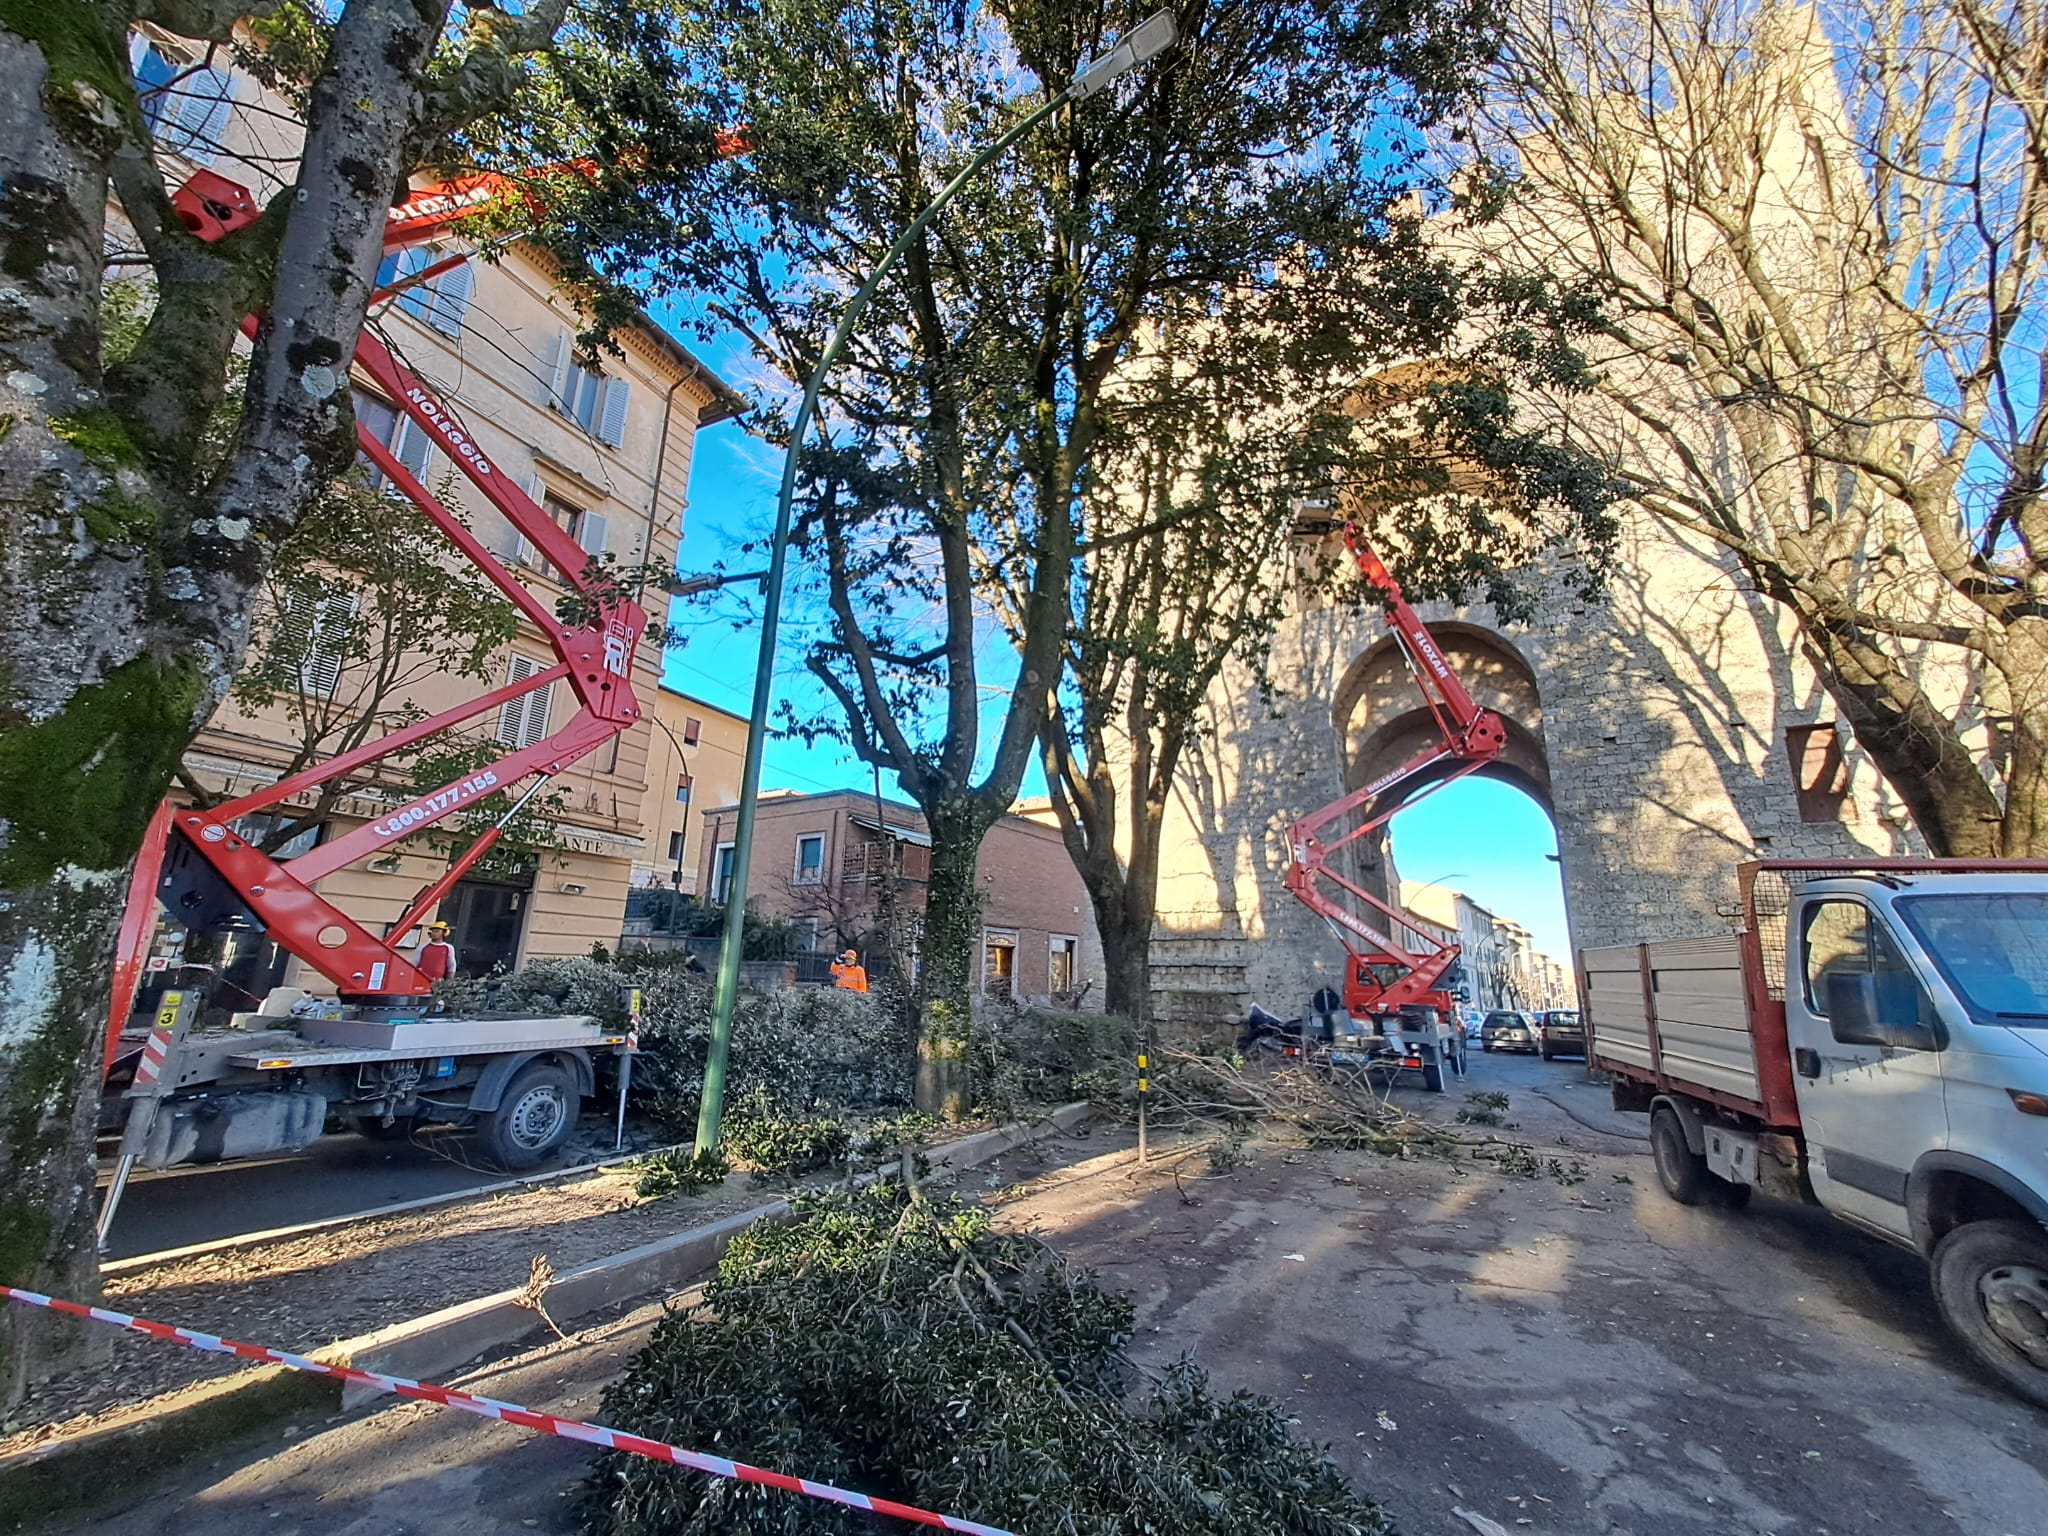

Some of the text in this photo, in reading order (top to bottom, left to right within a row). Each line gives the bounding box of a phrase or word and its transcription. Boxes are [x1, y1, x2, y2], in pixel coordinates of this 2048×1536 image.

[406, 387, 491, 474] NOLEGGIO
[1417, 638, 1449, 679] LOXAM
[1366, 767, 1406, 793] NOLEGGIO
[387, 771, 498, 833] 800.177.155
[160, 1012, 174, 1025] 3
